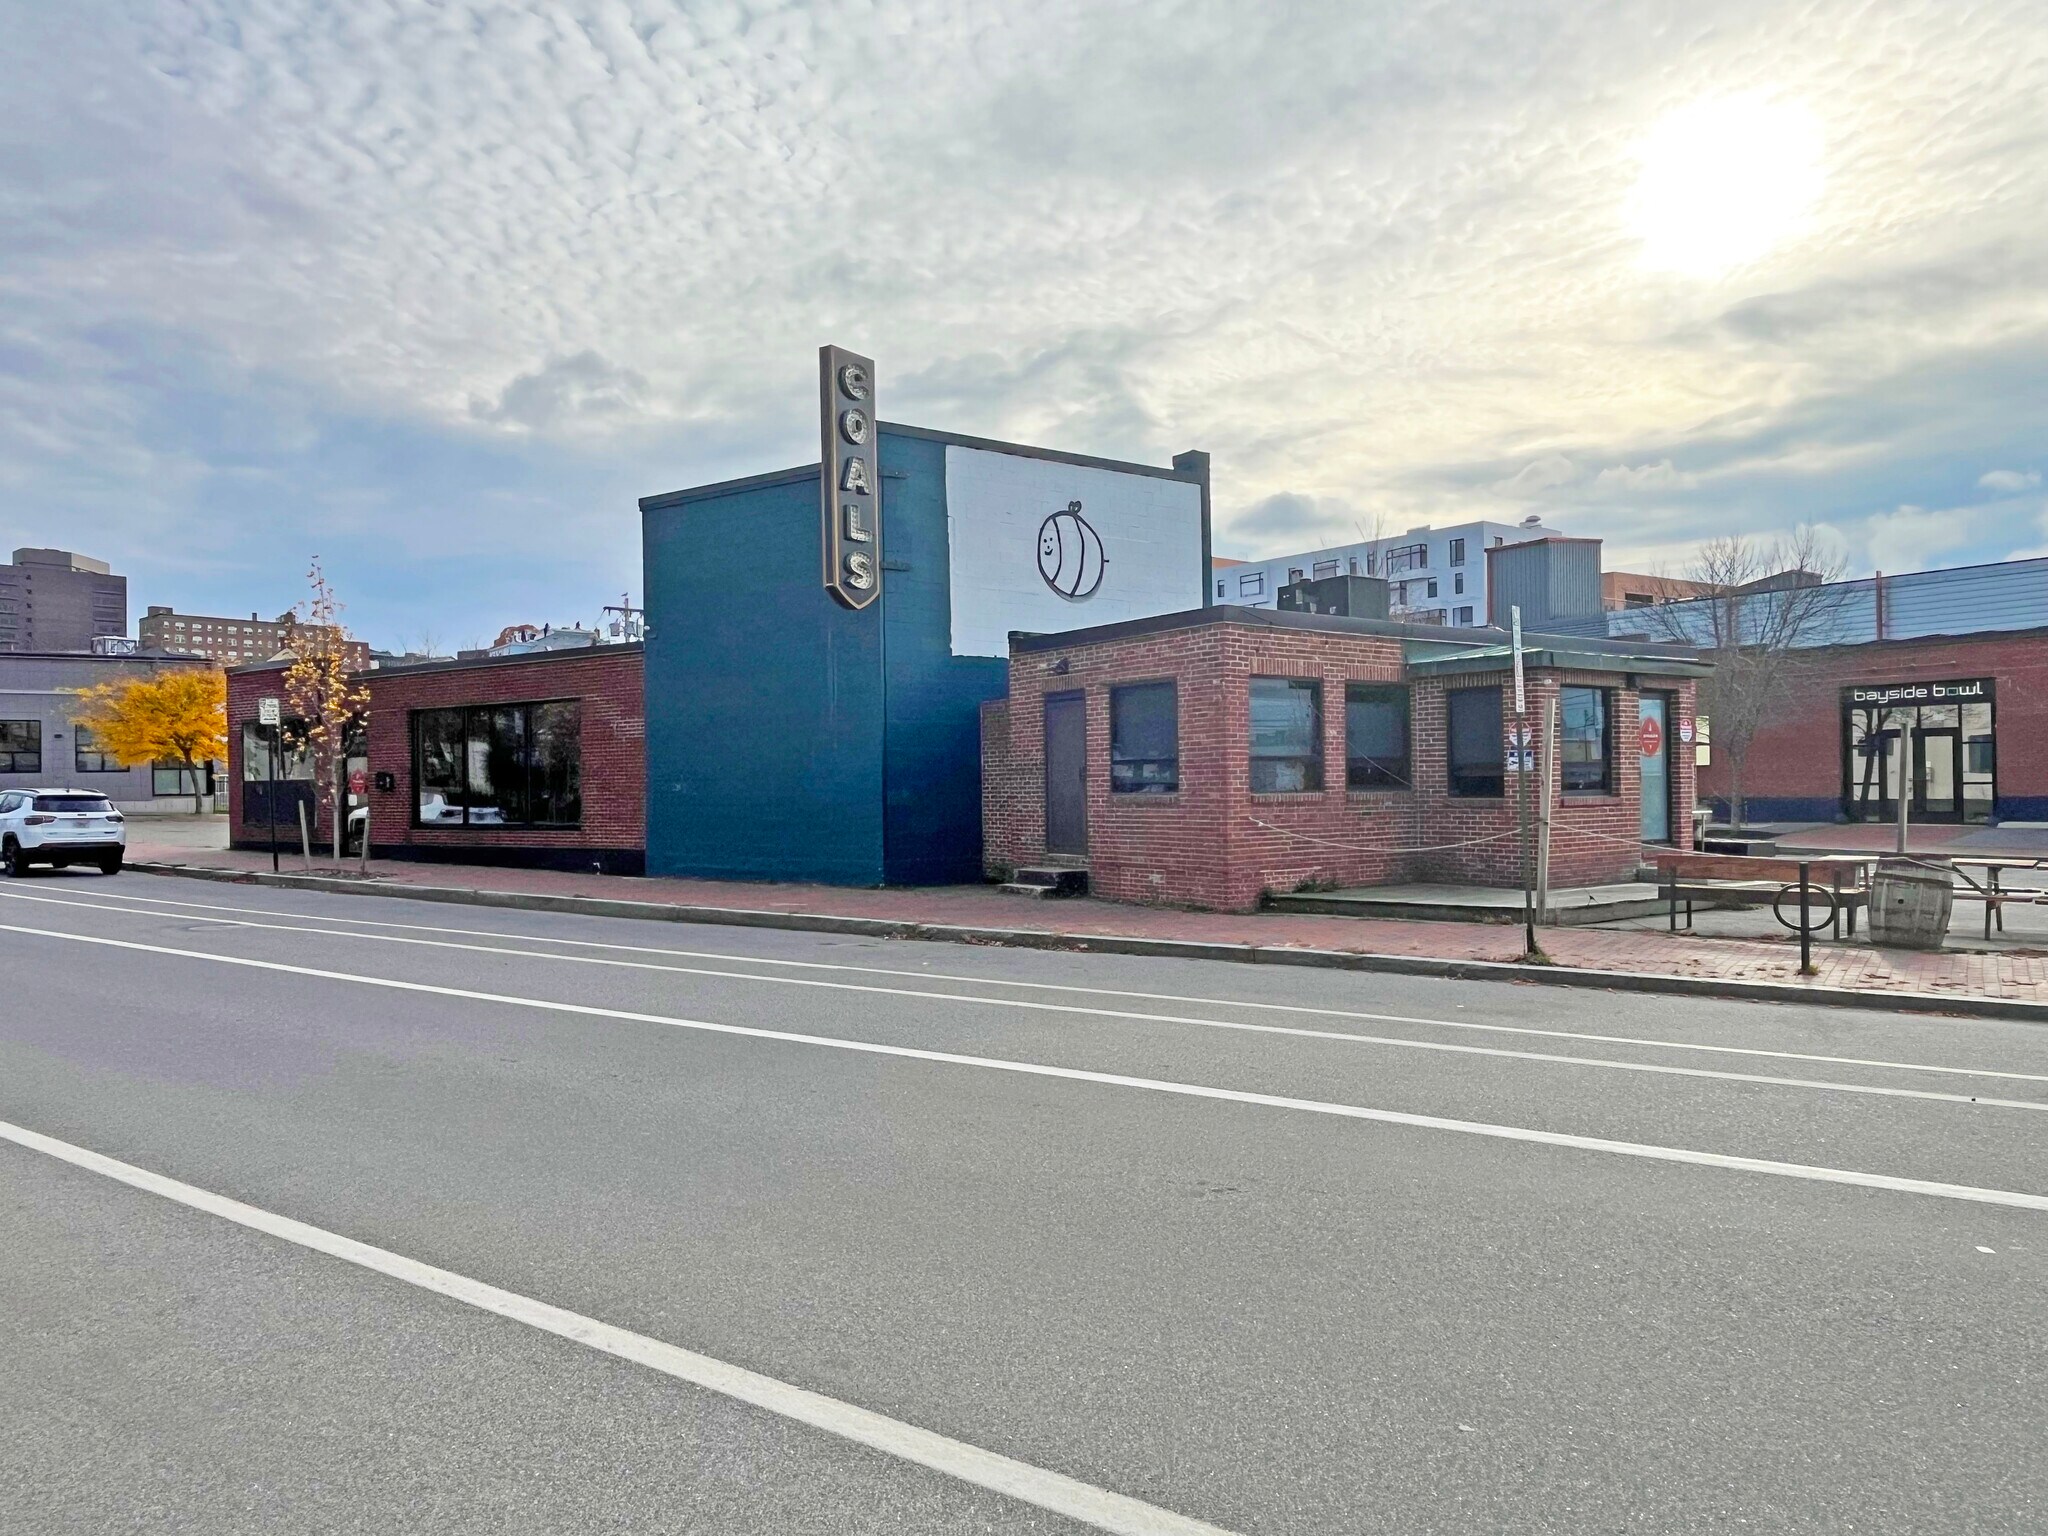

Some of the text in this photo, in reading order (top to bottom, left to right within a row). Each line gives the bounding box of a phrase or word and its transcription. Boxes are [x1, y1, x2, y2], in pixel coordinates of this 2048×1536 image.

[838, 363, 874, 590] COALS
[1854, 681, 1983, 703] bayside bowl
